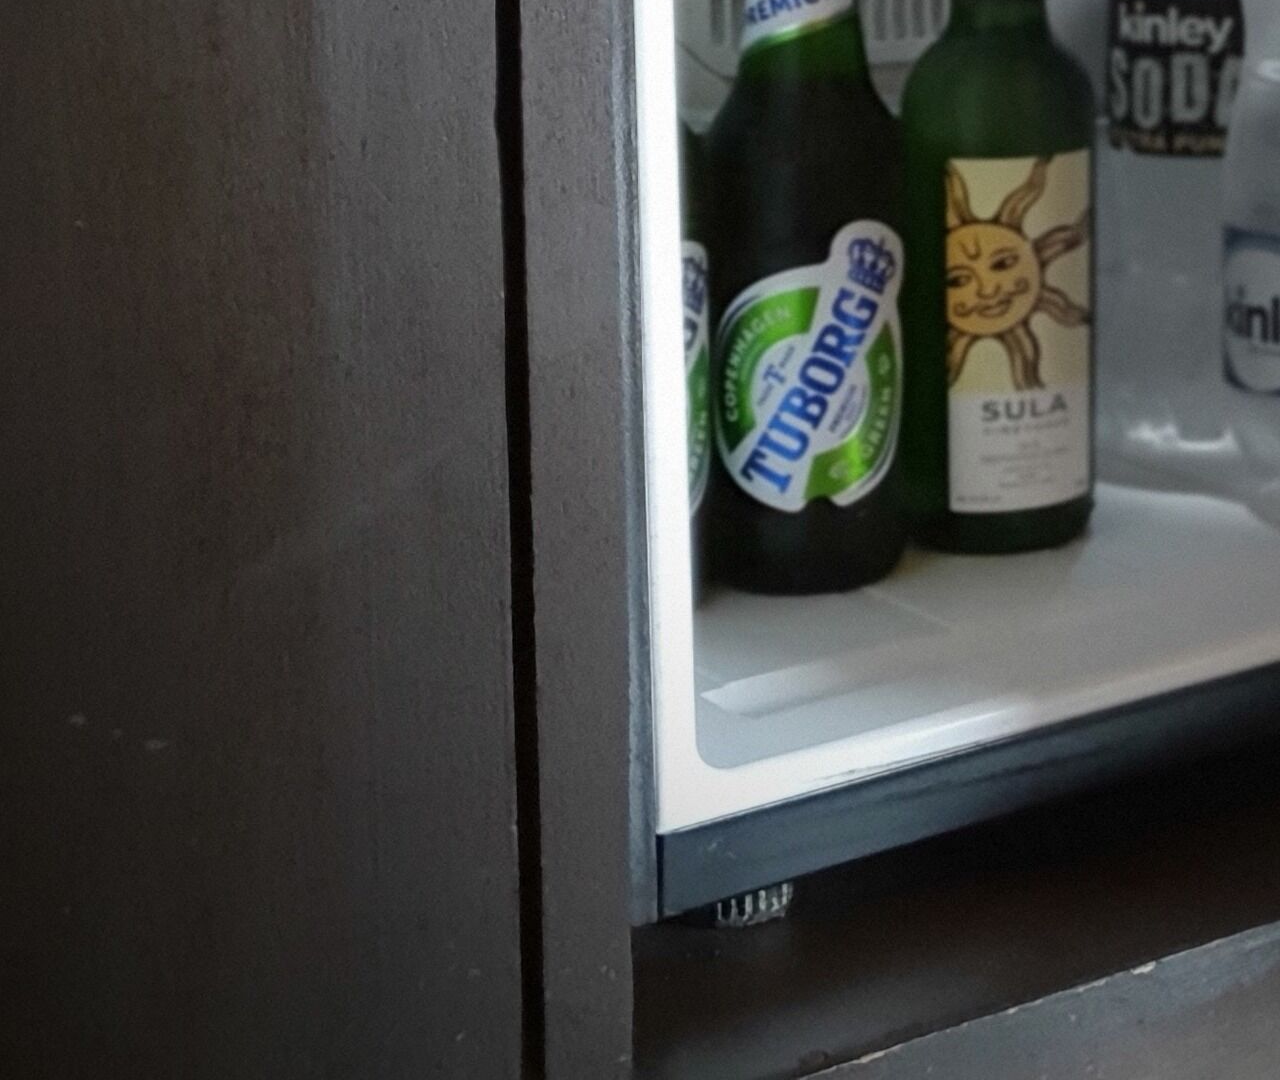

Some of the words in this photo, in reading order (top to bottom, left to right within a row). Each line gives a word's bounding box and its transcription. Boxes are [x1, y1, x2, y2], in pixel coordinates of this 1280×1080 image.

[1119, 0, 1235, 55] kinley
[740, 286, 879, 495] TUBORG
[981, 393, 1068, 423] SULA
